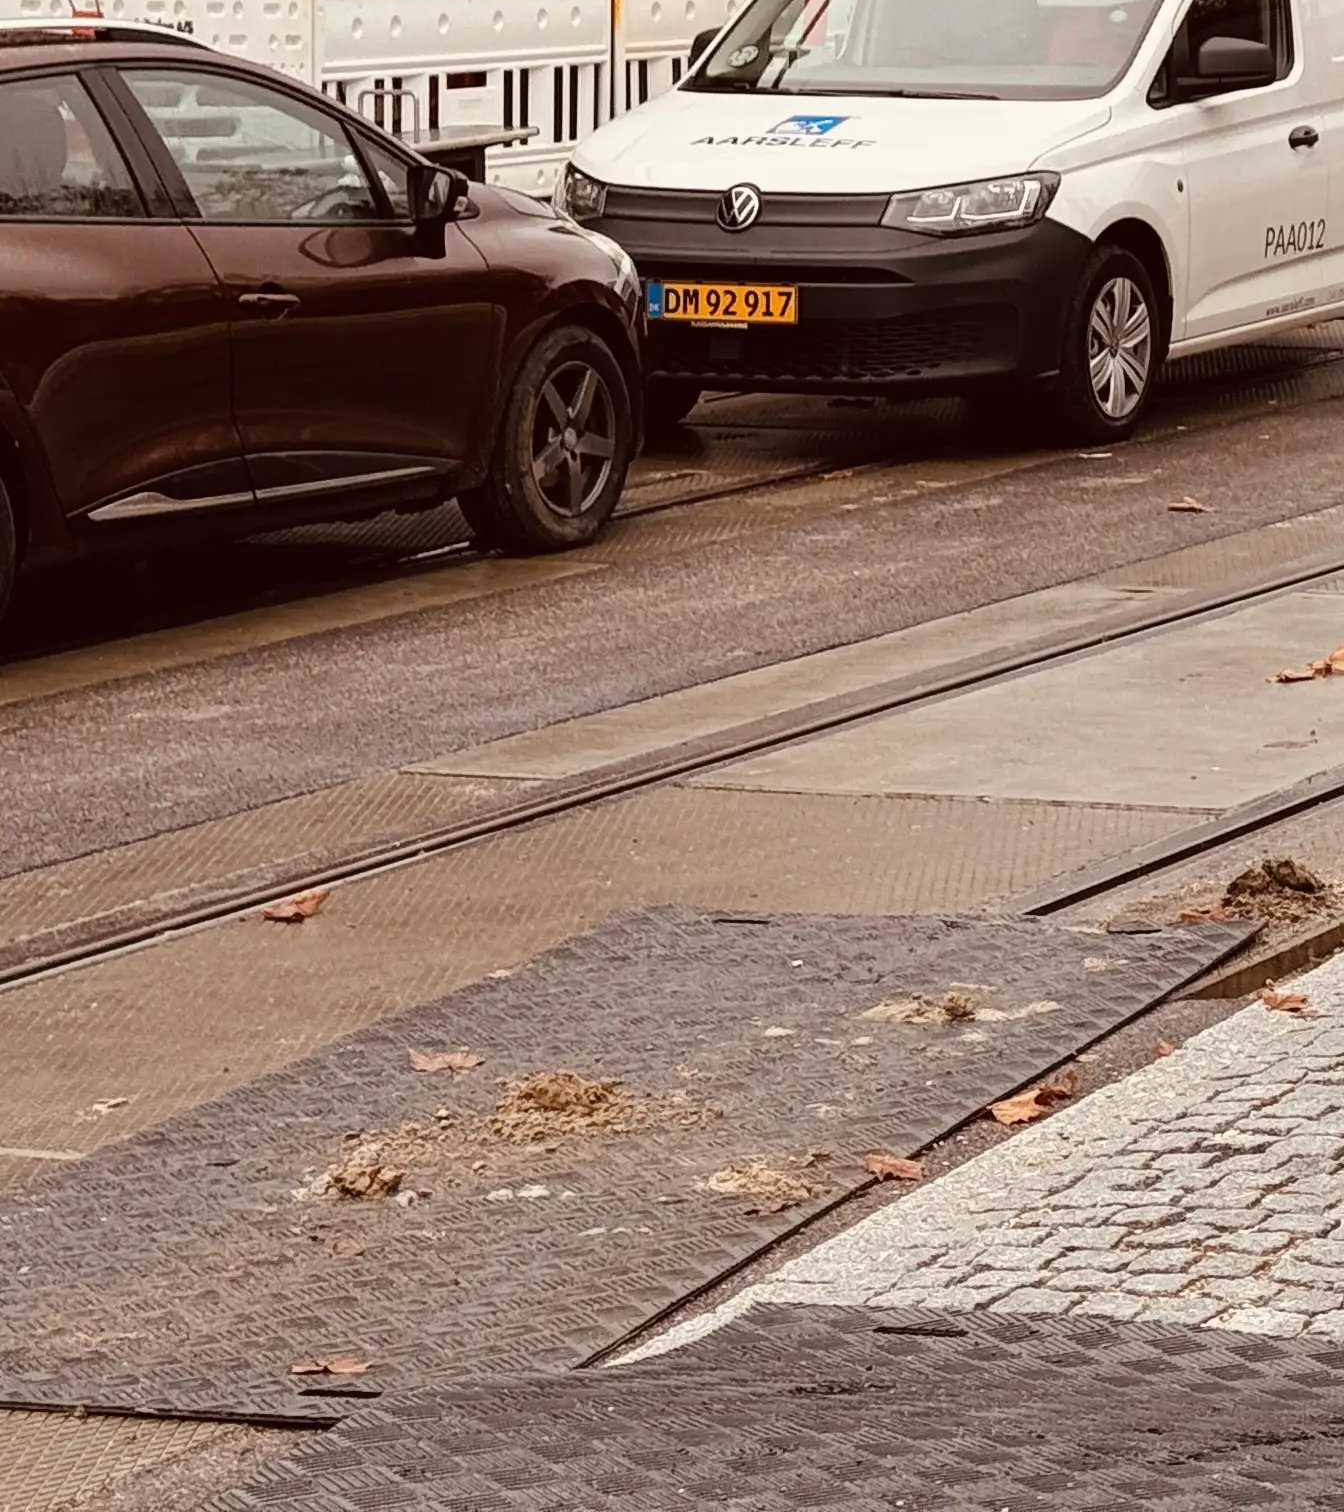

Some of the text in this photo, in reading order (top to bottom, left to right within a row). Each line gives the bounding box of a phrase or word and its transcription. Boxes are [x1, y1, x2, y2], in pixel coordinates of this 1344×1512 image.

[689, 136, 878, 150] AARSLEFF
[1264, 218, 1326, 259] PAA012
[664, 288, 700, 315] DM
[706, 289, 738, 317] 92
[744, 290, 793, 318] 917
